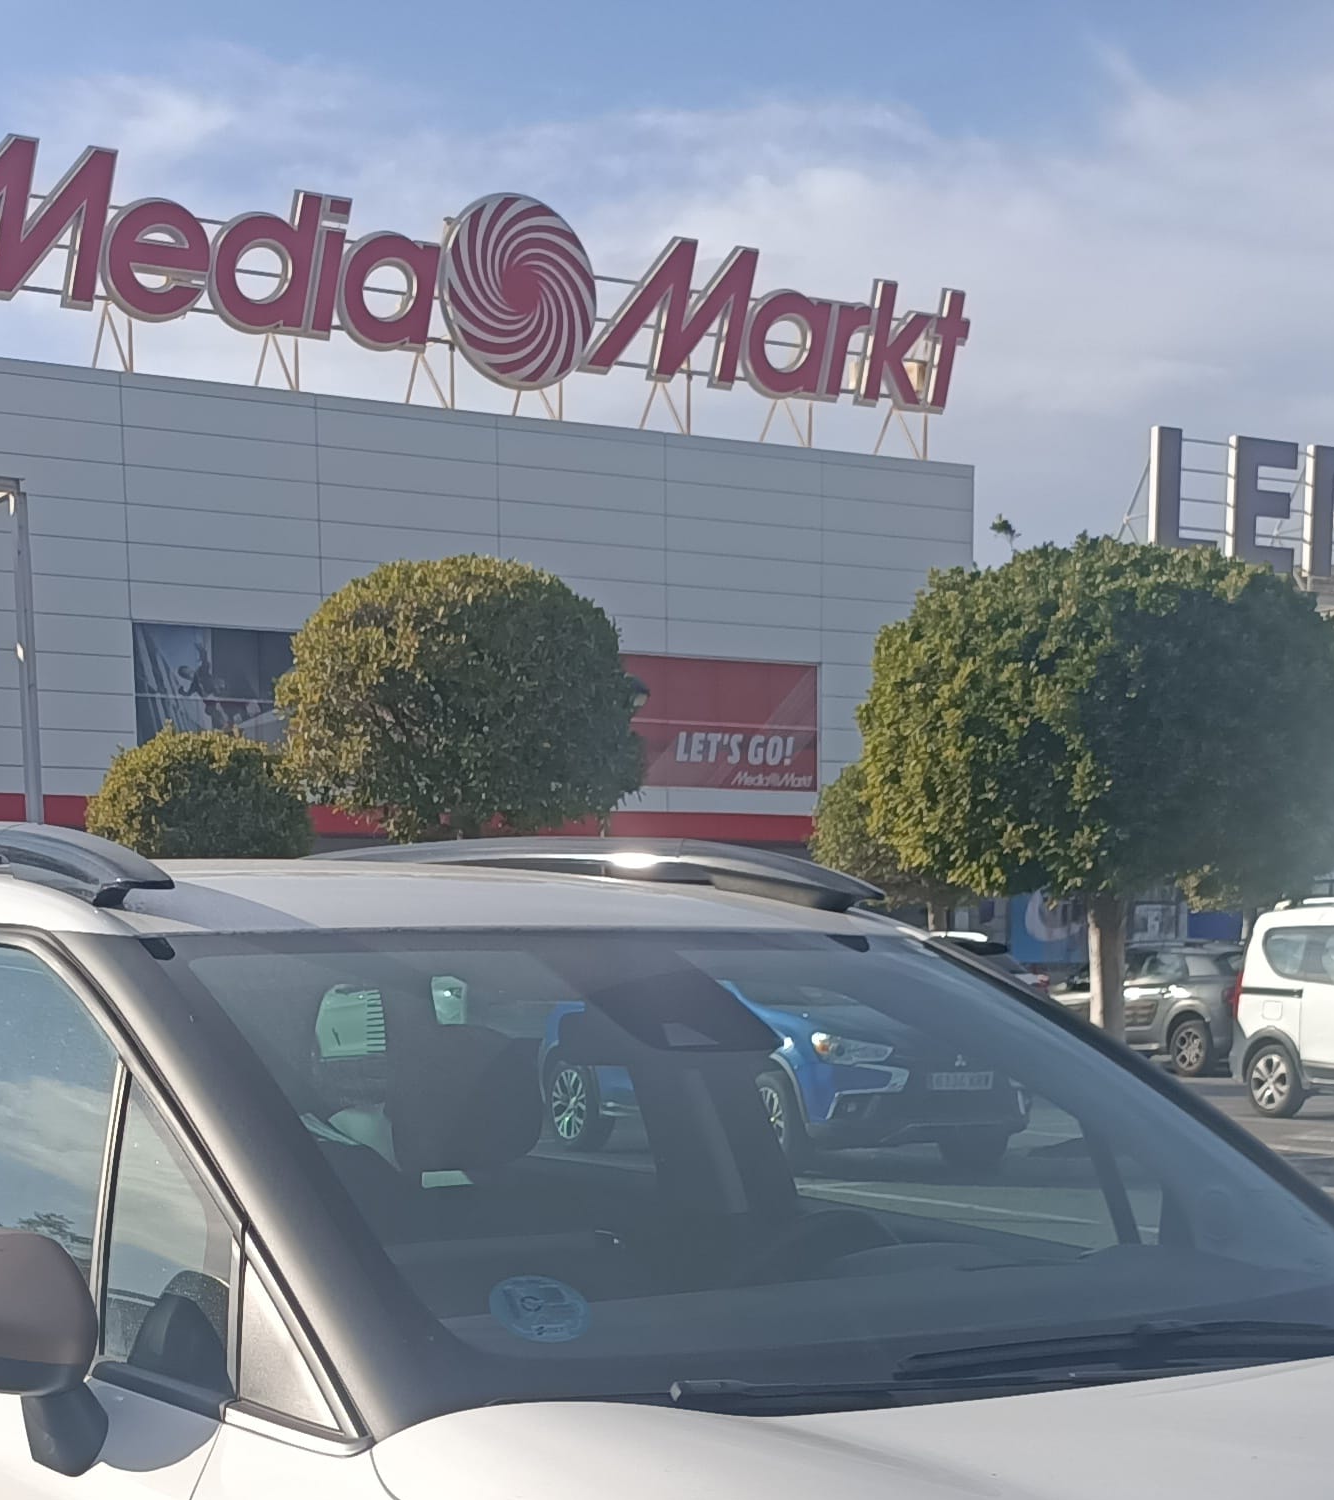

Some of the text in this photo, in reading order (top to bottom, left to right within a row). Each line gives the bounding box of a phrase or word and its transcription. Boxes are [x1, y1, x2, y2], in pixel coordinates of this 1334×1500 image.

[582, 236, 970, 414] Markt
[675, 731, 795, 766] LET'S GO!
